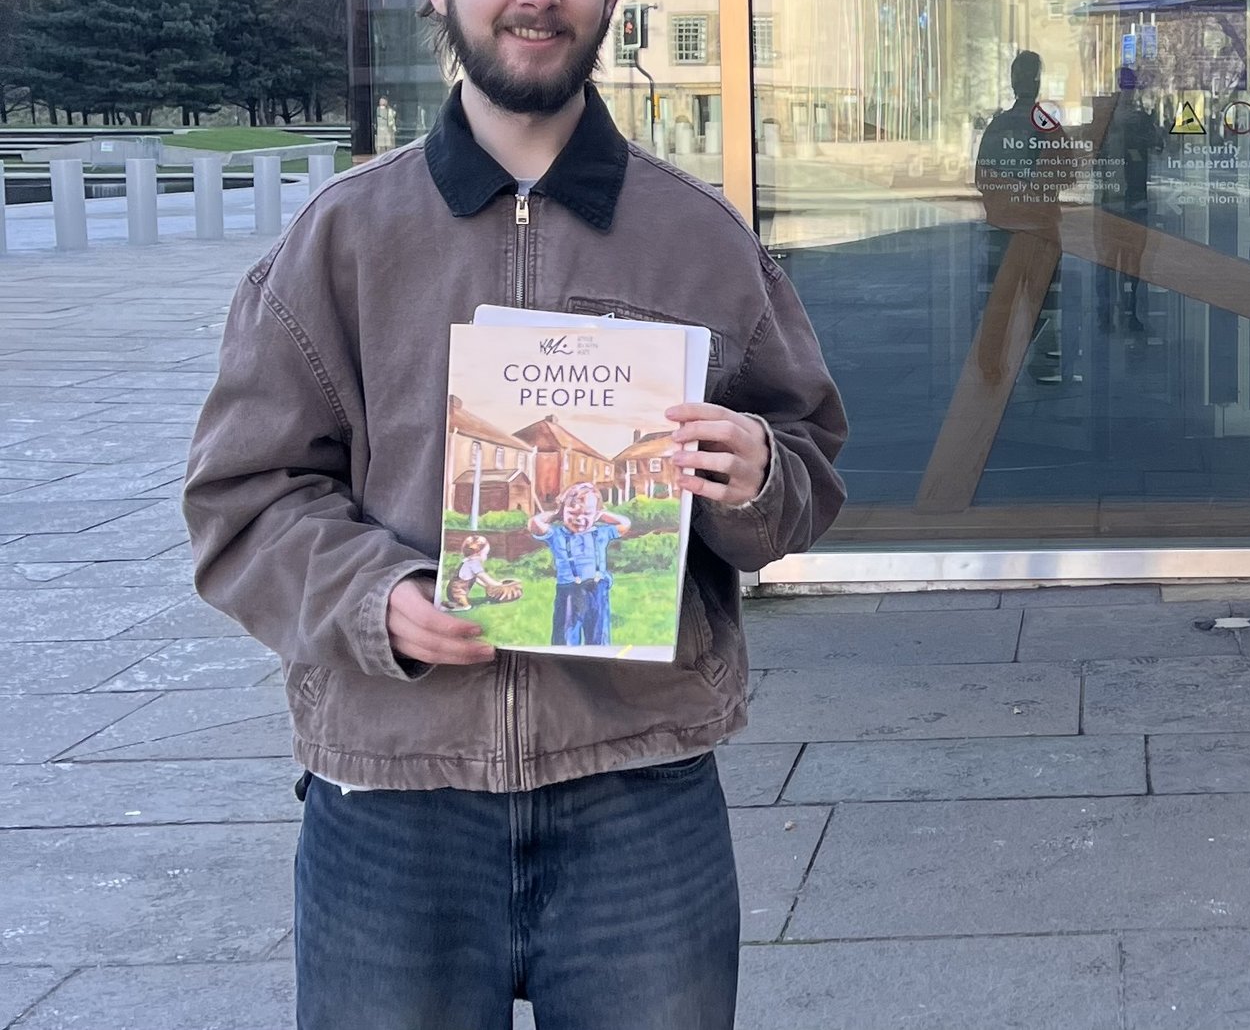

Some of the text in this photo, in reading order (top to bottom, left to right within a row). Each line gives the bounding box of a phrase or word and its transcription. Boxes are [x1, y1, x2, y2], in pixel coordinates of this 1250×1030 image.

[1003, 137, 1093, 152] No Smoking
[1183, 142, 1241, 158] Security
[1000, 158, 1017, 166] are
[1020, 158, 1033, 166] no
[1035, 155, 1078, 167] smoking
[1167, 156, 1181, 169] in
[1001, 170, 1014, 178] an
[1017, 167, 1054, 178] offence
[1057, 169, 1067, 178] to
[1105, 170, 1117, 178] or
[1030, 181, 1040, 191] to
[1010, 194, 1020, 203] in
[1023, 193, 1040, 203] this
[504, 363, 632, 384] COMMON
[520, 388, 615, 407] PEOPLE
